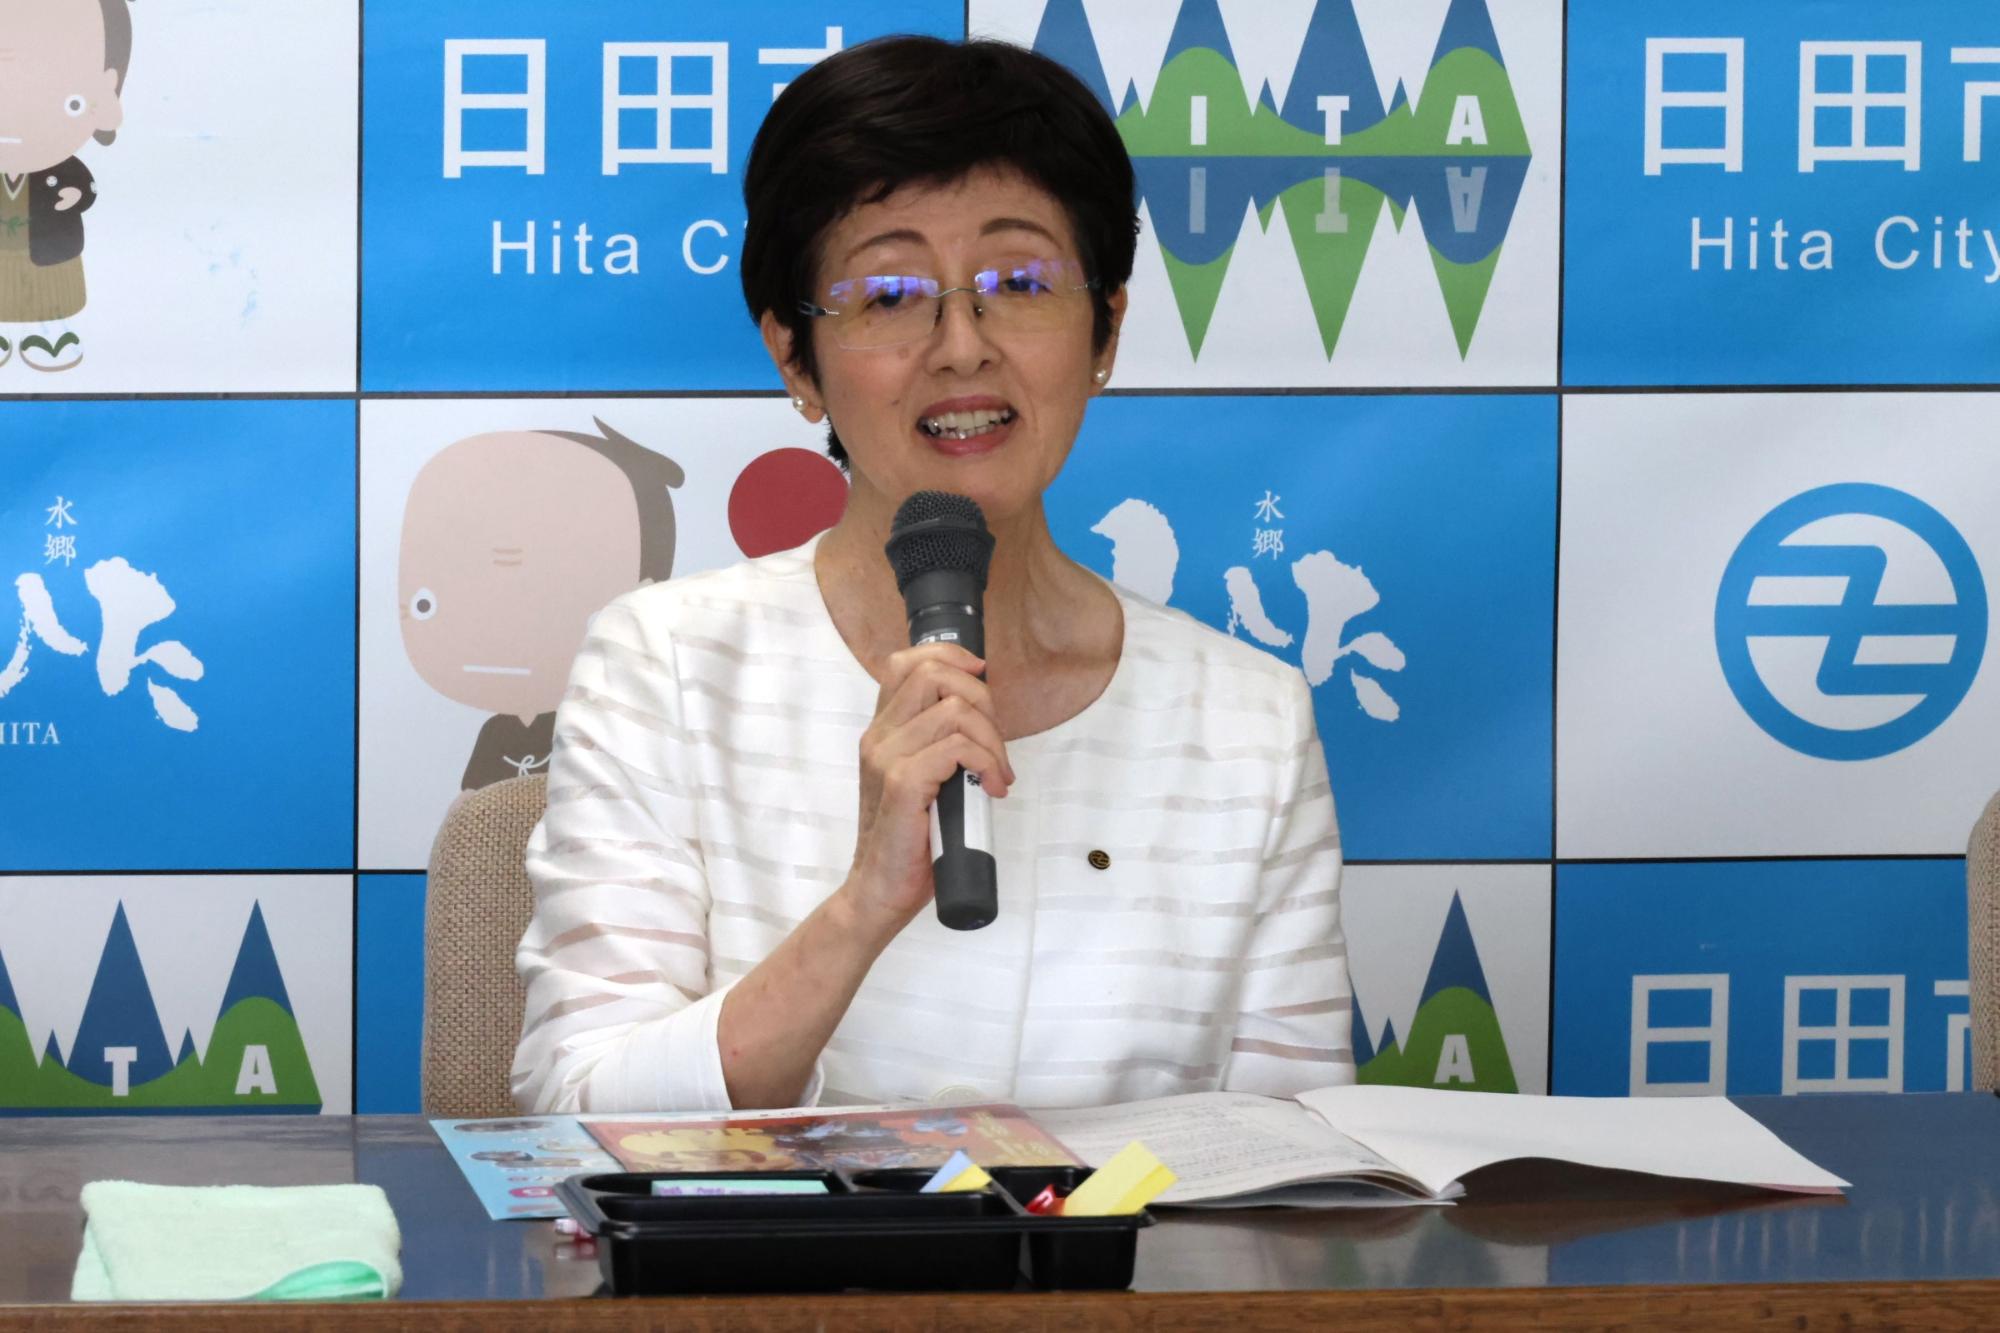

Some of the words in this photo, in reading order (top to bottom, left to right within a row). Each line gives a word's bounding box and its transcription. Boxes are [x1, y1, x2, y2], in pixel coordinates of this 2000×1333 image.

[1190, 95, 1488, 145] ITA
[492, 220, 640, 275] Hita
[1691, 217, 1834, 270] Hita
[45, 496, 77, 567] 水郷
[1253, 490, 1285, 560] 水郷
[104, 1044, 278, 1096] TA
